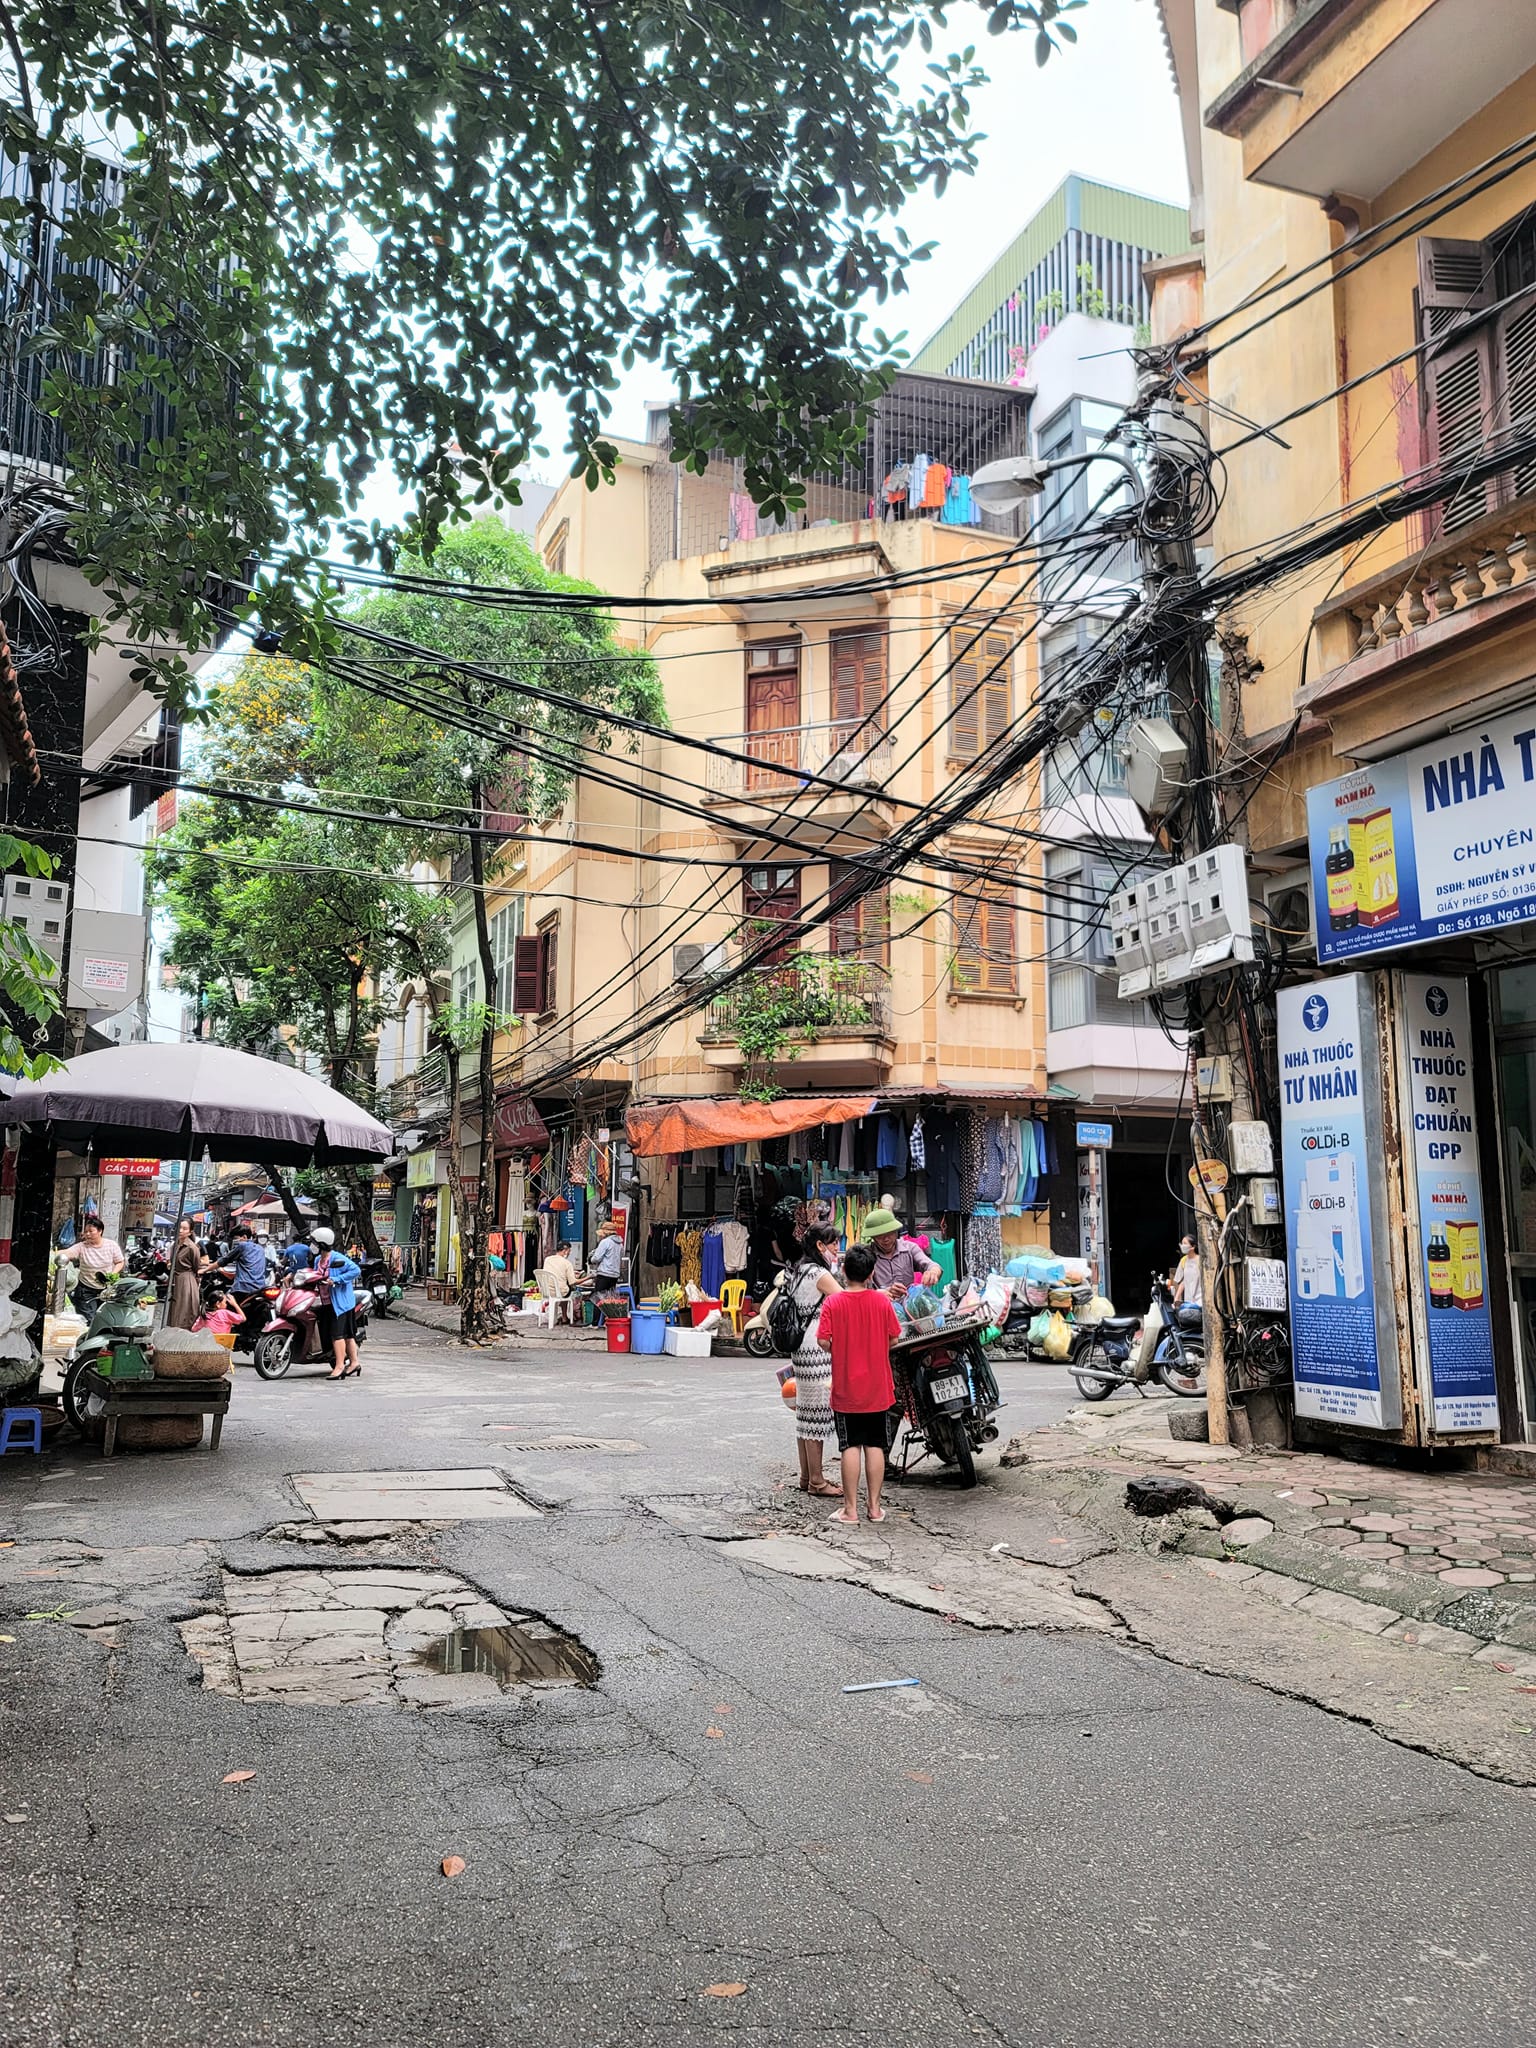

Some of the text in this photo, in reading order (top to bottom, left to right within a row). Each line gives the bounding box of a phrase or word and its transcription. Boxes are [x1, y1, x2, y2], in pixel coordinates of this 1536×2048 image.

[1423, 734, 1505, 813] NHÀ
[1335, 783, 1376, 807] NAM HÀ
[1453, 828, 1533, 861] CHUYÊN
[1468, 868, 1509, 889] NGUYỄN
[1436, 896, 1459, 913] GIẤY
[1462, 890, 1489, 908] PHÉP
[1492, 885, 1510, 900] SỐ:
[1457, 915, 1471, 931] Số
[1473, 911, 1495, 927] 128,
[1497, 906, 1520, 925] Ngõ
[1420, 1027, 1456, 1049] NHÀ
[1284, 1038, 1354, 1069] NHÀ THUỐC
[1412, 1053, 1466, 1077] THUỐC
[1284, 1065, 1358, 1104] TƯ NHÂN
[1425, 1086, 1457, 1107] ĐẠT
[1414, 1107, 1472, 1133] CHUẨN
[1428, 1142, 1462, 1160] GPP
[105, 1163, 154, 1174] CÁC LOẠI
[1431, 1192, 1468, 1204] NAM HÀ
[935, 1376, 960, 1391] 89-K1
